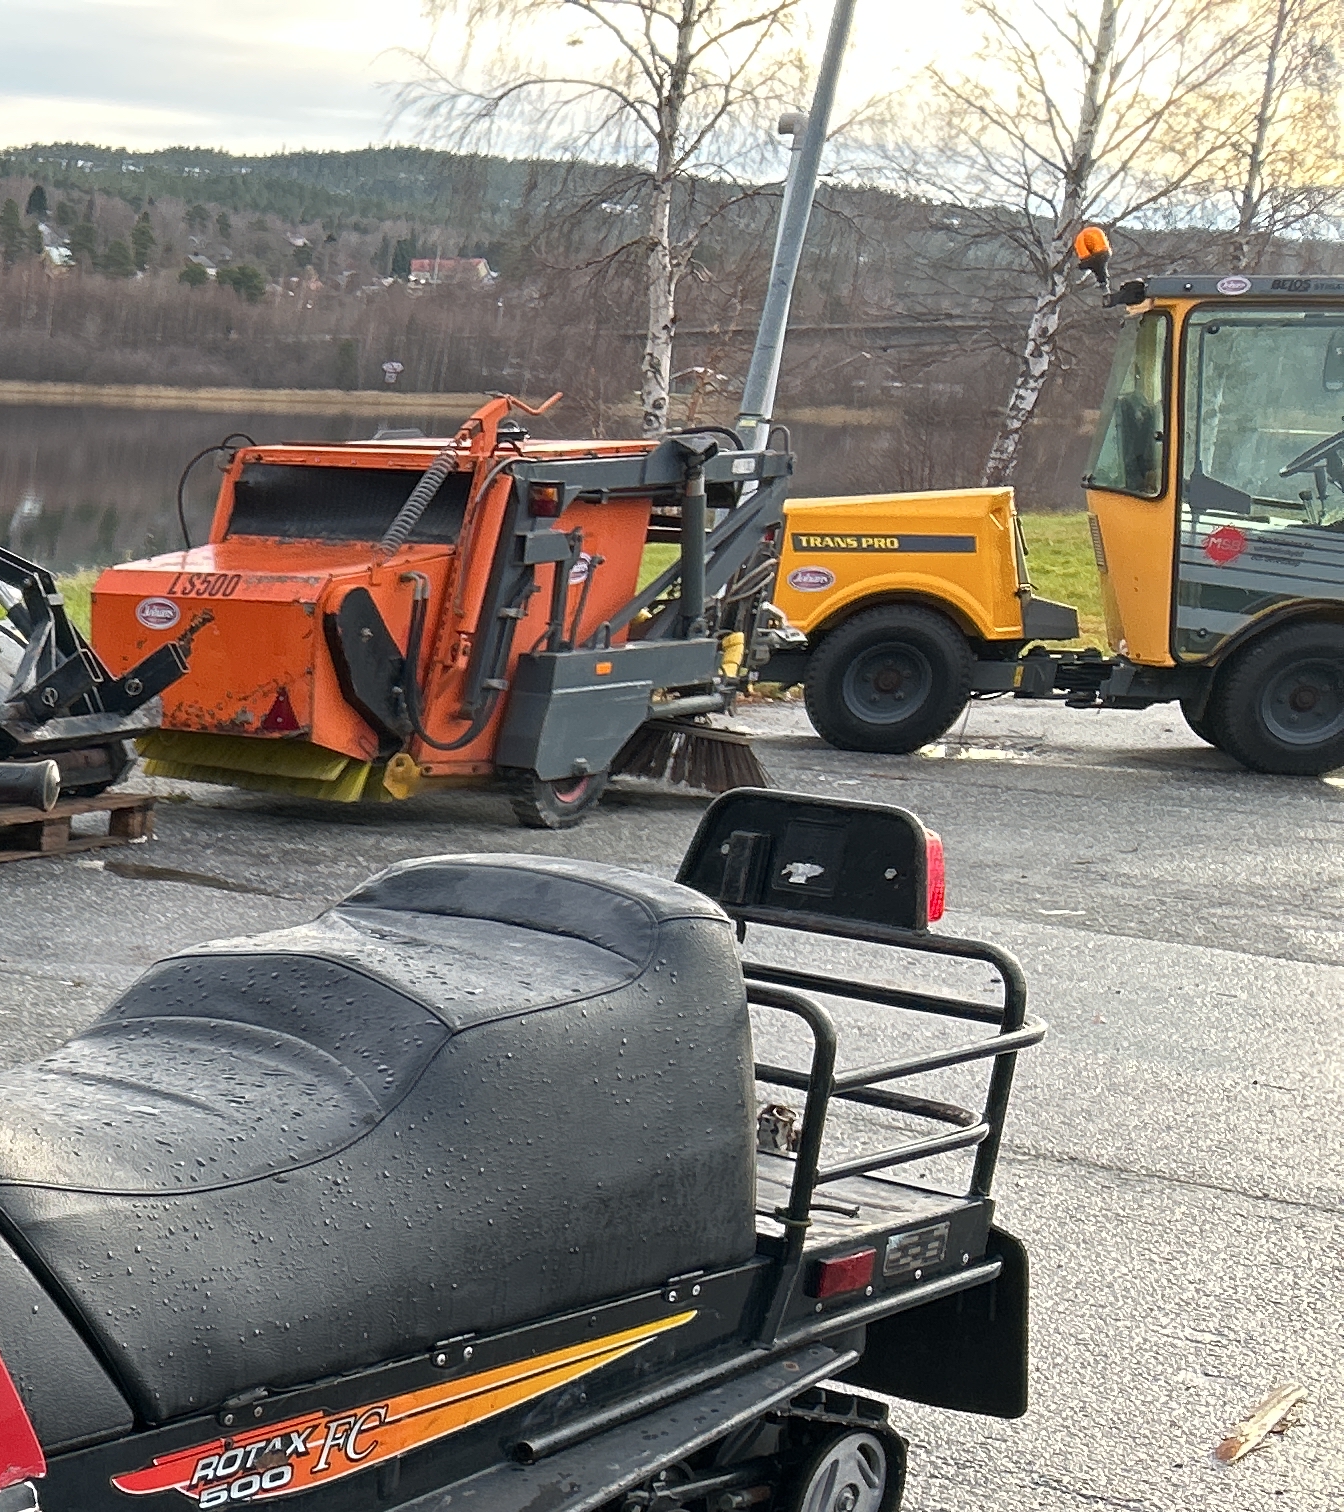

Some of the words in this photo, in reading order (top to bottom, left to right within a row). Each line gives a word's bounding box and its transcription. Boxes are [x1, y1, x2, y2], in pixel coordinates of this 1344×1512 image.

[798, 535, 858, 549] TRANS
[862, 537, 900, 550] PRO
[166, 572, 242, 598] LS500
[311, 1404, 390, 1473] FC
[198, 1464, 294, 1510] 500
